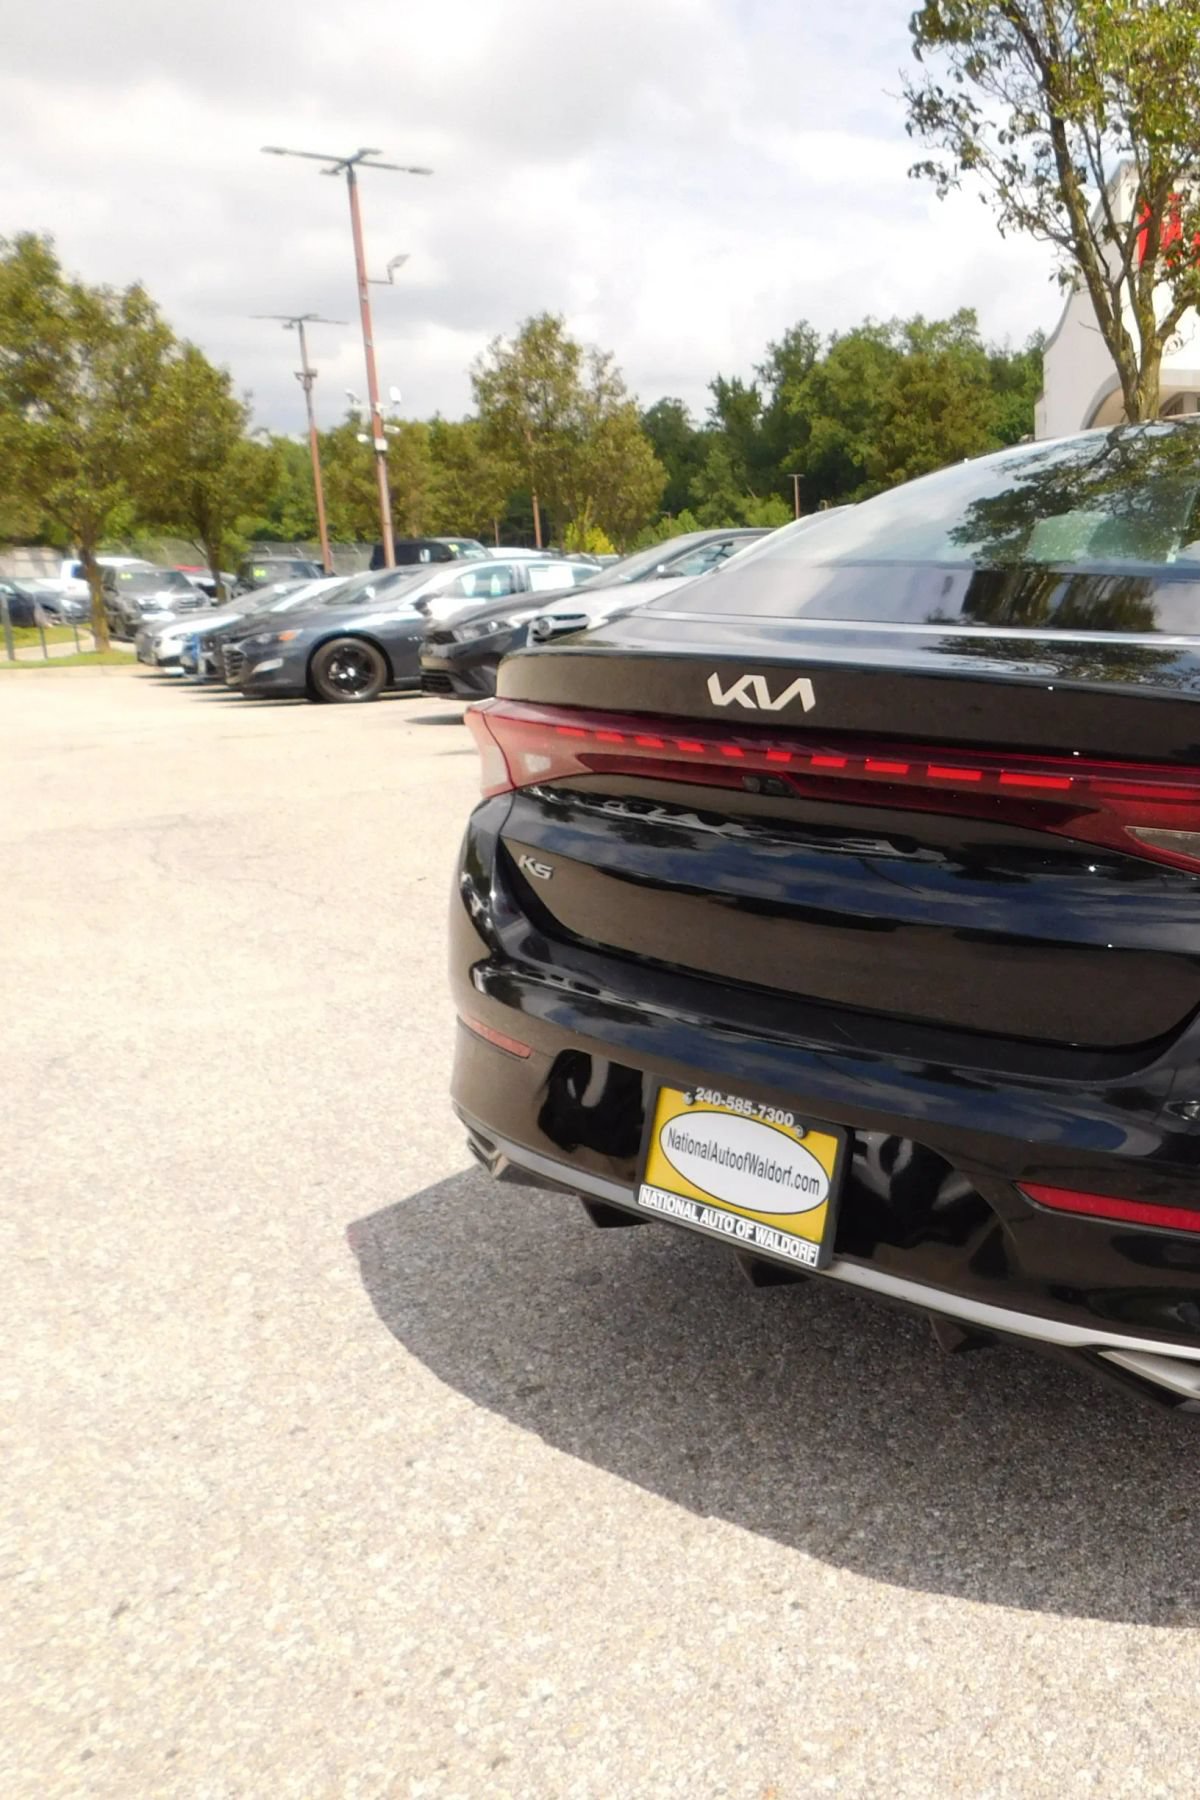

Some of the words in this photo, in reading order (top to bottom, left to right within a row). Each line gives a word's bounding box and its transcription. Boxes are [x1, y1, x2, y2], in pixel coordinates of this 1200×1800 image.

[707, 672, 816, 712] KIA
[518, 854, 553, 880] K5
[695, 1087, 795, 1126] 240-585-7300
[667, 1127, 820, 1196] NationalAutoofWaldorf.com
[641, 1187, 699, 1221] NATIONAL
[700, 1206, 735, 1233] AUTO
[736, 1220, 754, 1244] OF
[754, 1227, 818, 1264] WALDORF
